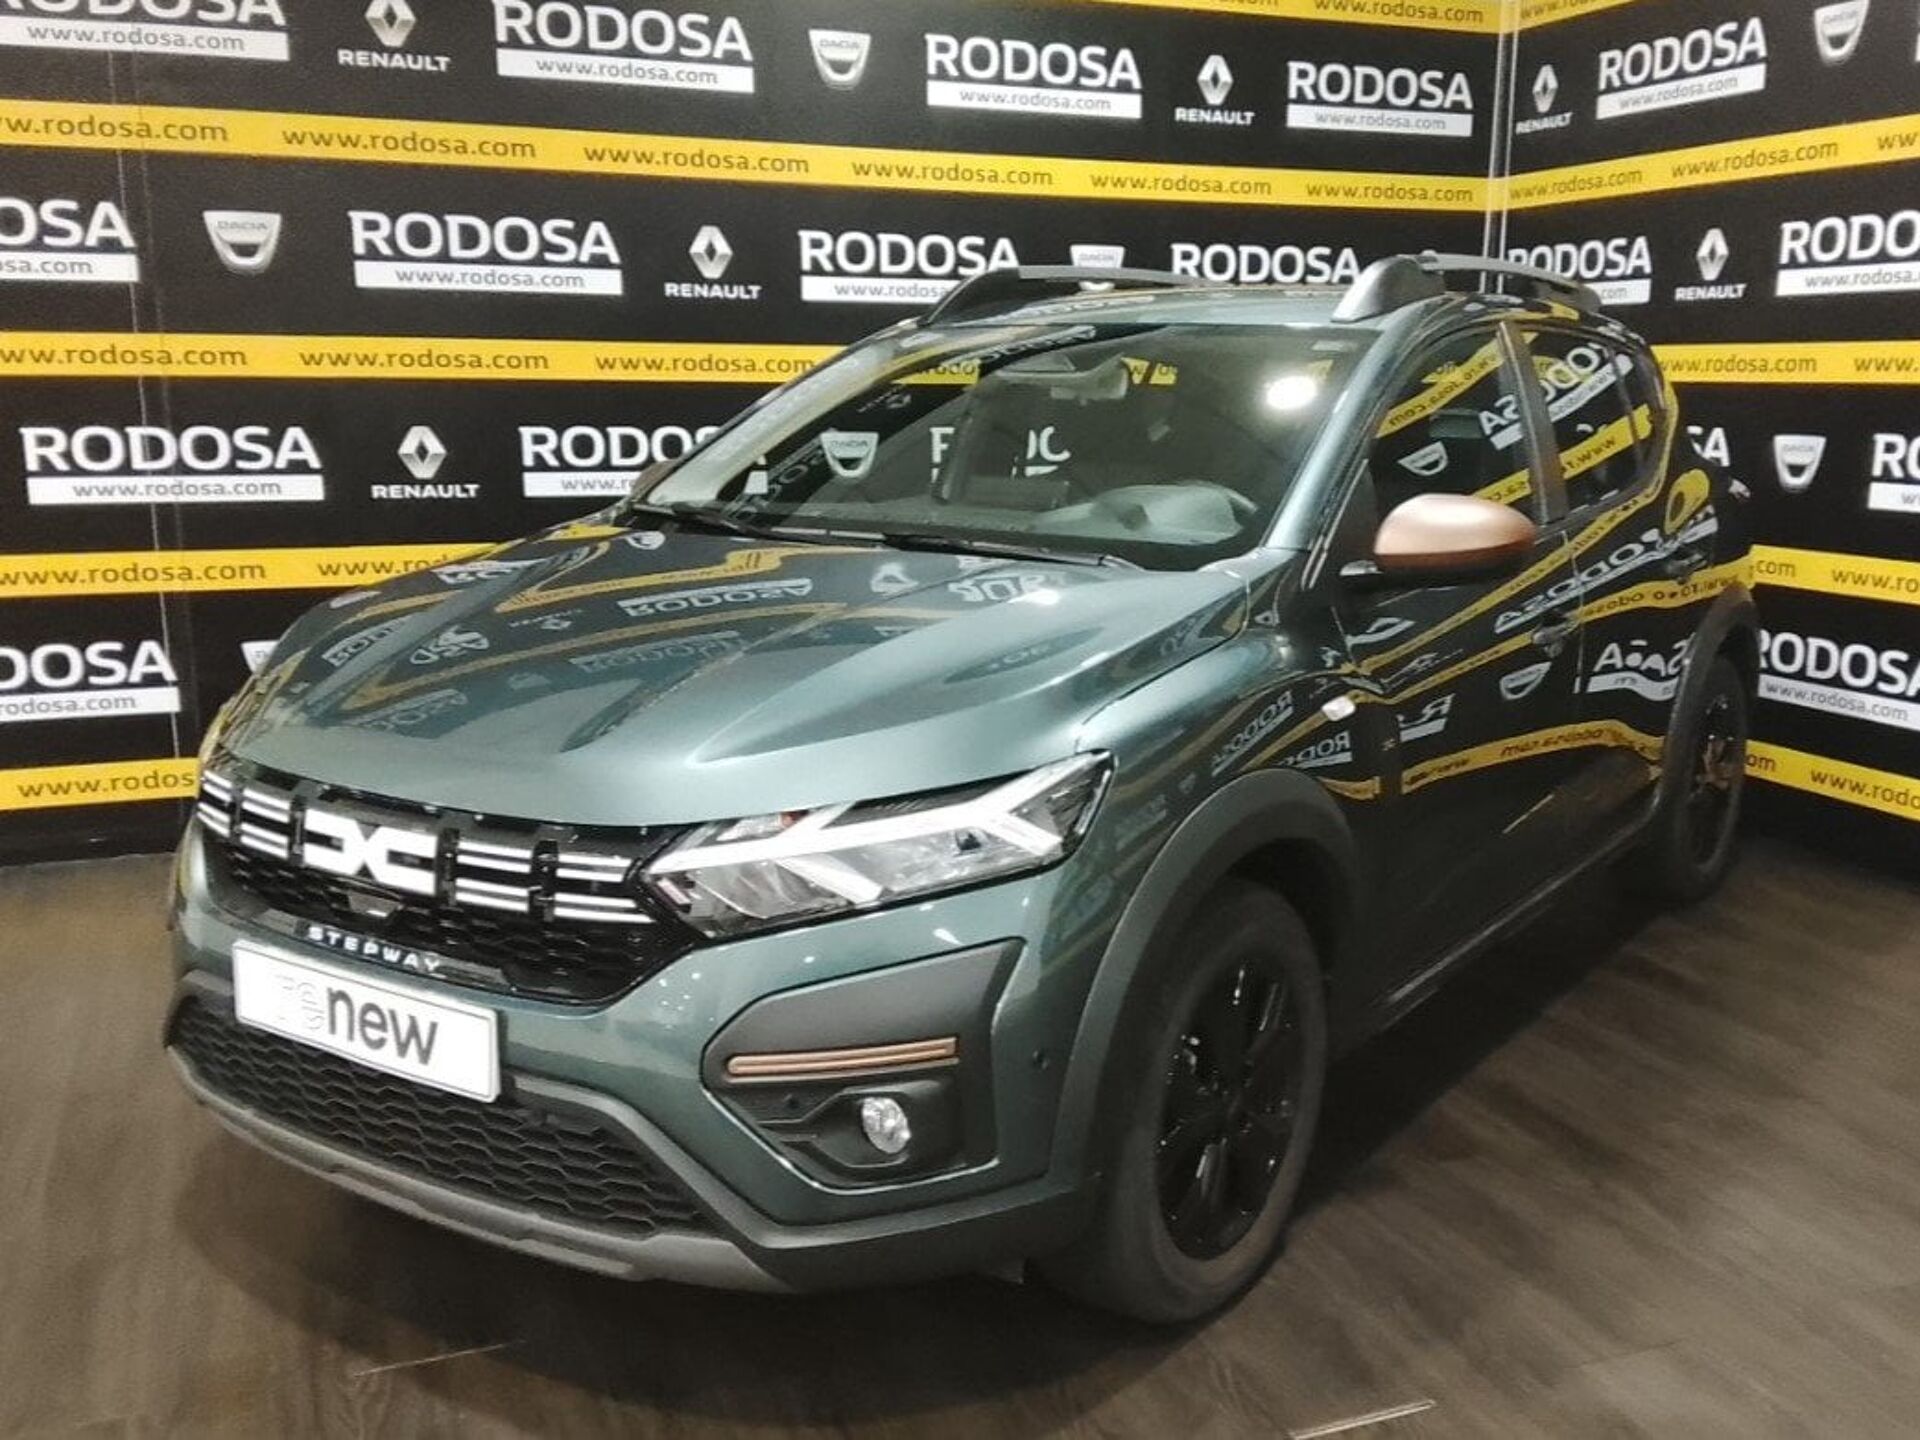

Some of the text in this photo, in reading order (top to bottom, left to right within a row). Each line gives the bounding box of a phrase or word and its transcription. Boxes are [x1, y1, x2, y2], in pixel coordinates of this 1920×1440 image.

[27, 25, 245, 51] www.rodosa.com
[493, 0, 753, 62] RODOSA
[337, 49, 452, 72] RENAULT
[924, 33, 1142, 90] RODOSA
[1599, 17, 1768, 90] RODOSA
[536, 56, 718, 84] www.rodosa.com
[1287, 60, 1473, 109] RODOSA
[1618, 75, 1738, 109] www.rodosa.com
[959, 87, 1112, 112] www.rodosa.com
[0, 115, 228, 142] w.rodosa.com
[1175, 107, 1255, 125] RENAULT
[1315, 112, 1446, 130] www.rodosa.com
[1515, 112, 1573, 135] RENAULT
[282, 128, 537, 159] www.rodosa.com
[583, 144, 810, 173] www.rodosa.com
[1670, 141, 1840, 179] www.rodosa.com
[851, 159, 1053, 186] www.rodosa.com
[1091, 171, 1272, 195] www.rodosa.com
[1305, 180, 1474, 203] www.rodosa.com
[347, 210, 622, 265] RODOSA
[798, 230, 1020, 275] RODOSA
[1171, 243, 1362, 284] RODOSA
[0, 258, 94, 275] sa.com
[395, 268, 586, 289] www.rodosa.com
[663, 282, 762, 300] RENAULT
[1674, 284, 1748, 302] RENAULT
[300, 350, 550, 371] www.rodosa.com
[595, 352, 815, 374] www.rodosa.com
[19, 425, 322, 472] RODOSA
[518, 425, 722, 467] RODO
[72, 480, 283, 498] www.rodosa.com
[370, 483, 480, 500] RENAULT
[1765, 681, 1909, 721] www.rodosa.com
[308, 926, 440, 972] STEPWAY
